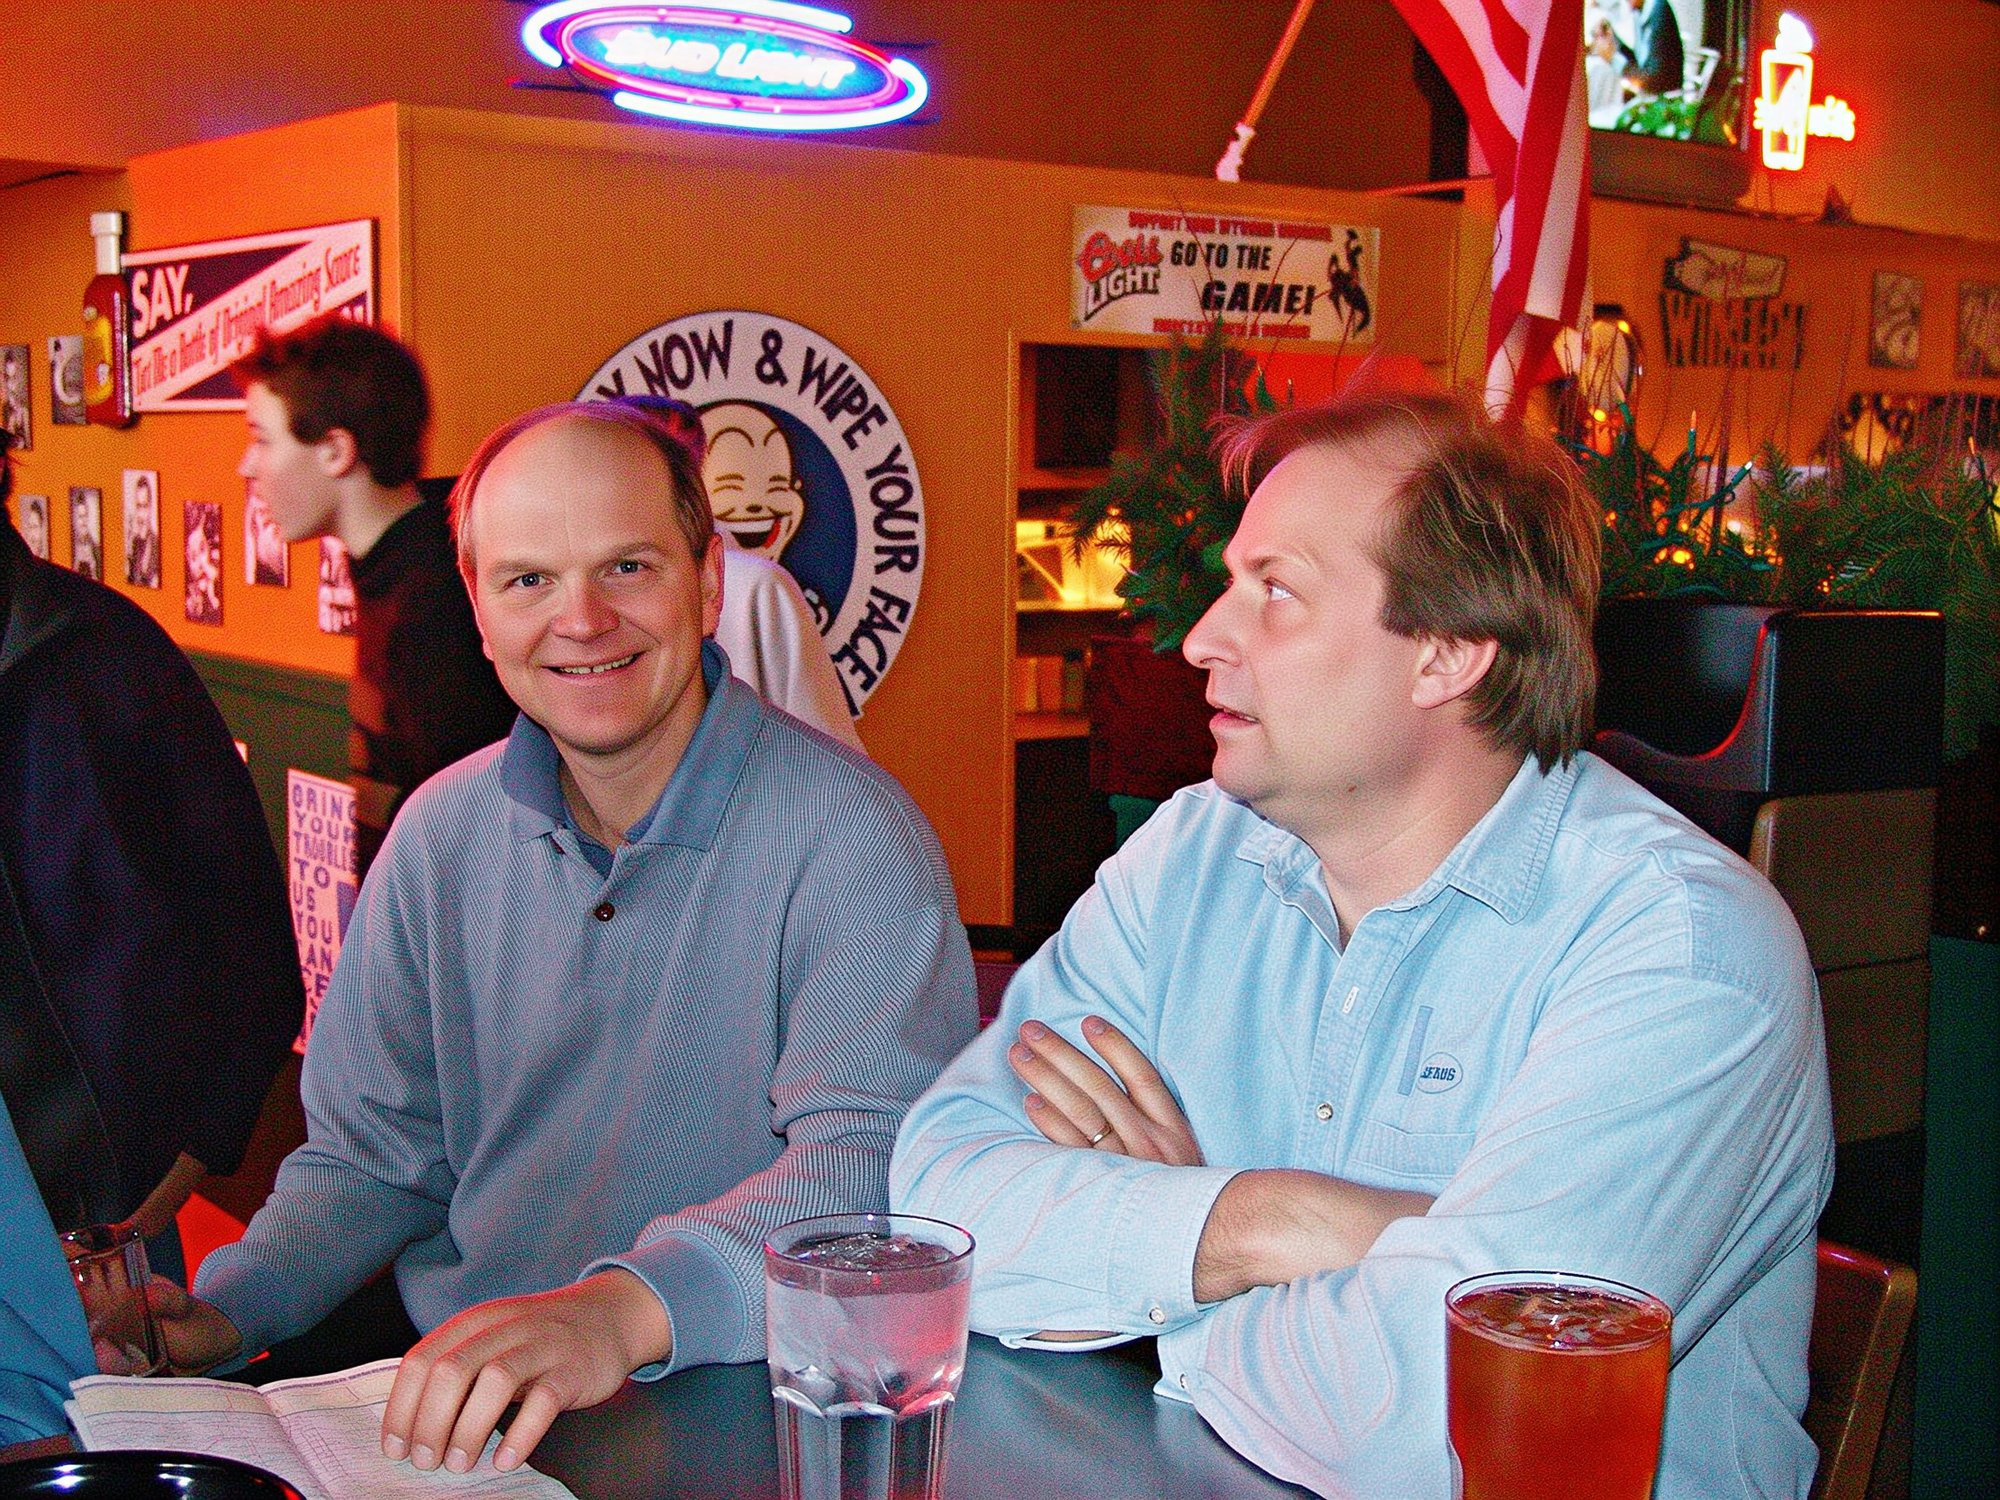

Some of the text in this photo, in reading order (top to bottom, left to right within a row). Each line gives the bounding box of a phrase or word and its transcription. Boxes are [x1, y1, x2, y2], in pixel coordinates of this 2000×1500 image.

[1170, 240, 1272, 271] GO TO THE
[131, 264, 194, 338] SAY,
[1084, 265, 1160, 318] LIGHT
[1200, 280, 1316, 316] GAME!
[633, 318, 733, 398] NOW
[754, 328, 788, 387] &
[798, 346, 888, 451] WIPE
[864, 442, 919, 575] YOUR
[294, 857, 331, 889] TO
[293, 881, 316, 912] US
[295, 911, 333, 945] YOU
